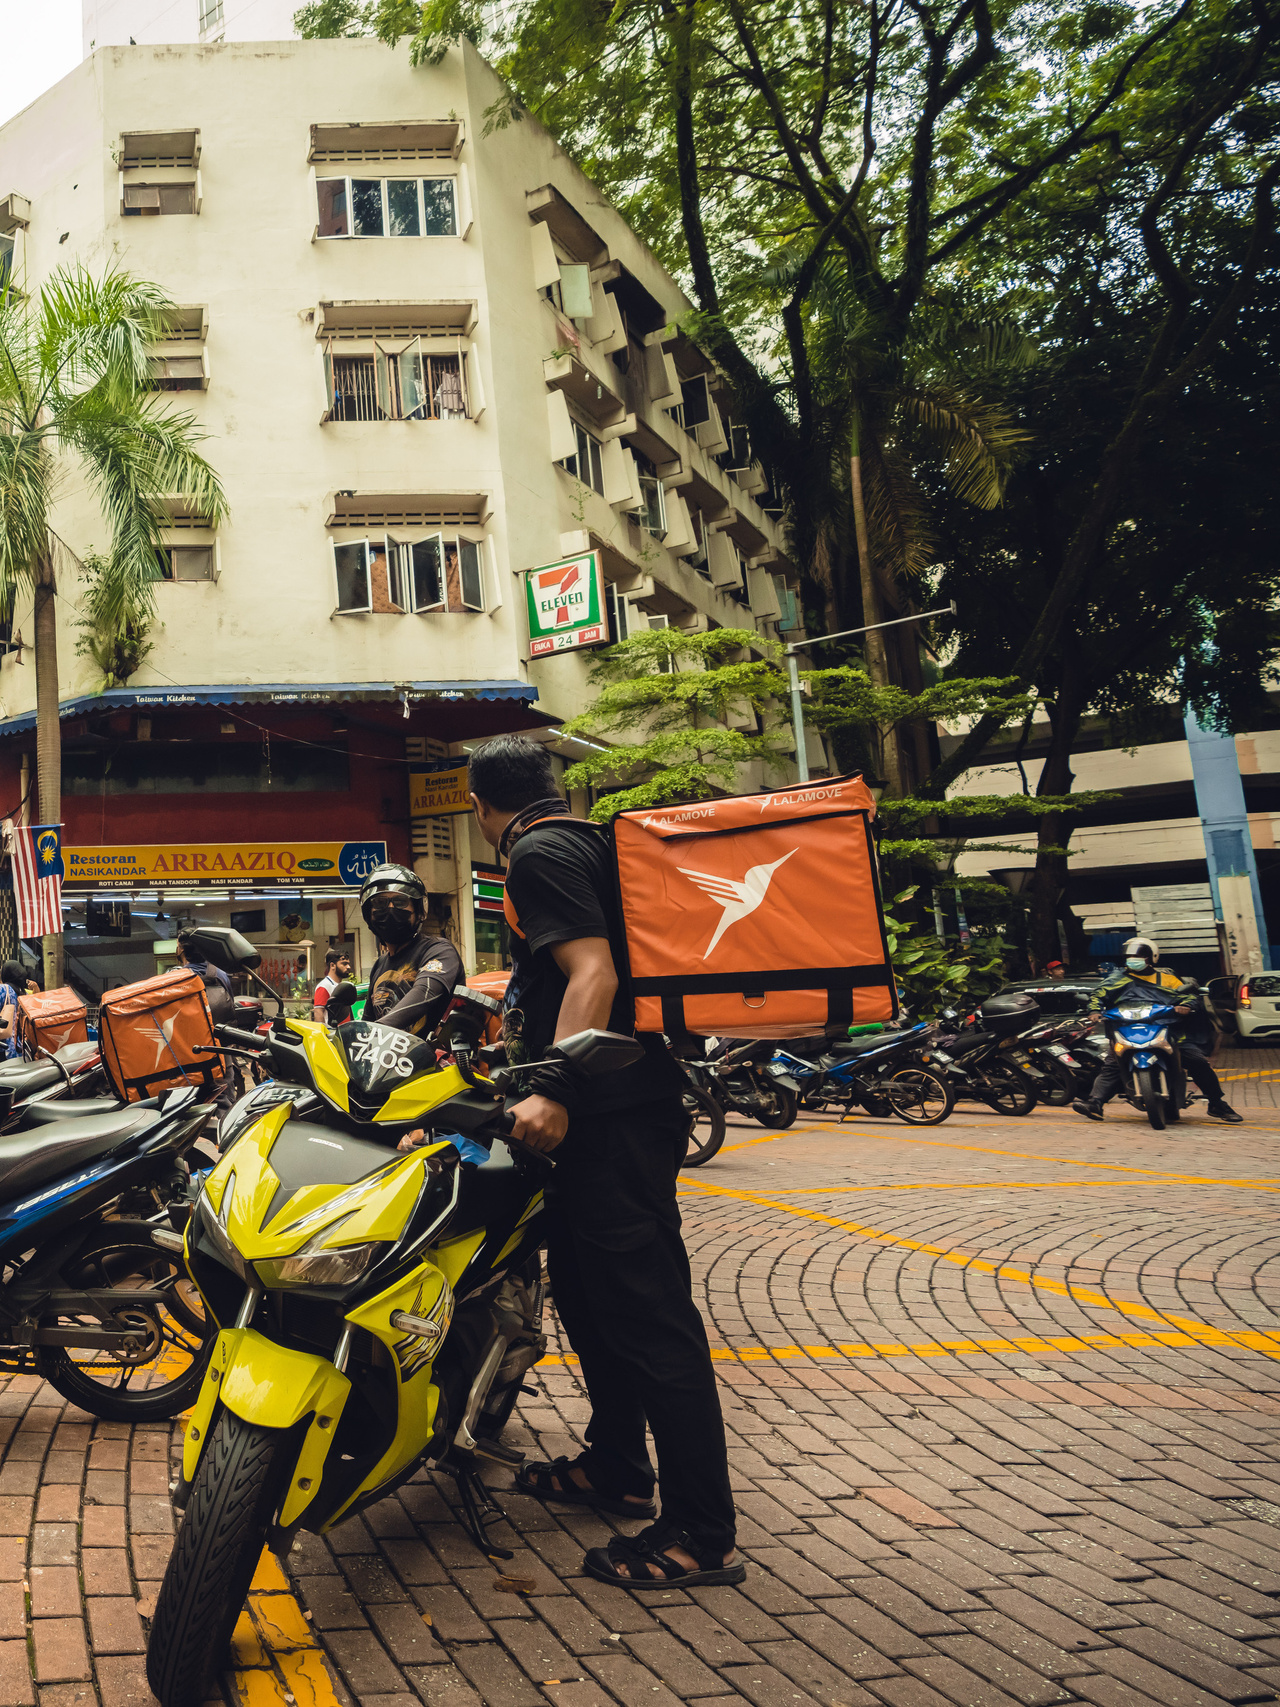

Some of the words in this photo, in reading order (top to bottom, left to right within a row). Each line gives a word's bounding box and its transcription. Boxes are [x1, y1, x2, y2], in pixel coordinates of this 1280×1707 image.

[534, 641, 551, 652] BUKA
[557, 635, 573, 648] 24
[583, 629, 597, 640] JAM
[135, 695, 164, 703] Taiwan
[166, 694, 196, 702] Kitchen
[424, 776, 458, 787] Restoran
[773, 787, 843, 807] LALAMOVE
[652, 808, 716, 826] LALAMOVE
[69, 854, 137, 865] Restoran
[151, 851, 296, 875] ARRAAZIQ
[70, 866, 147, 877] NASIKANDAR
[356, 1027, 411, 1054] JVB
[349, 1041, 414, 1077] 7409
